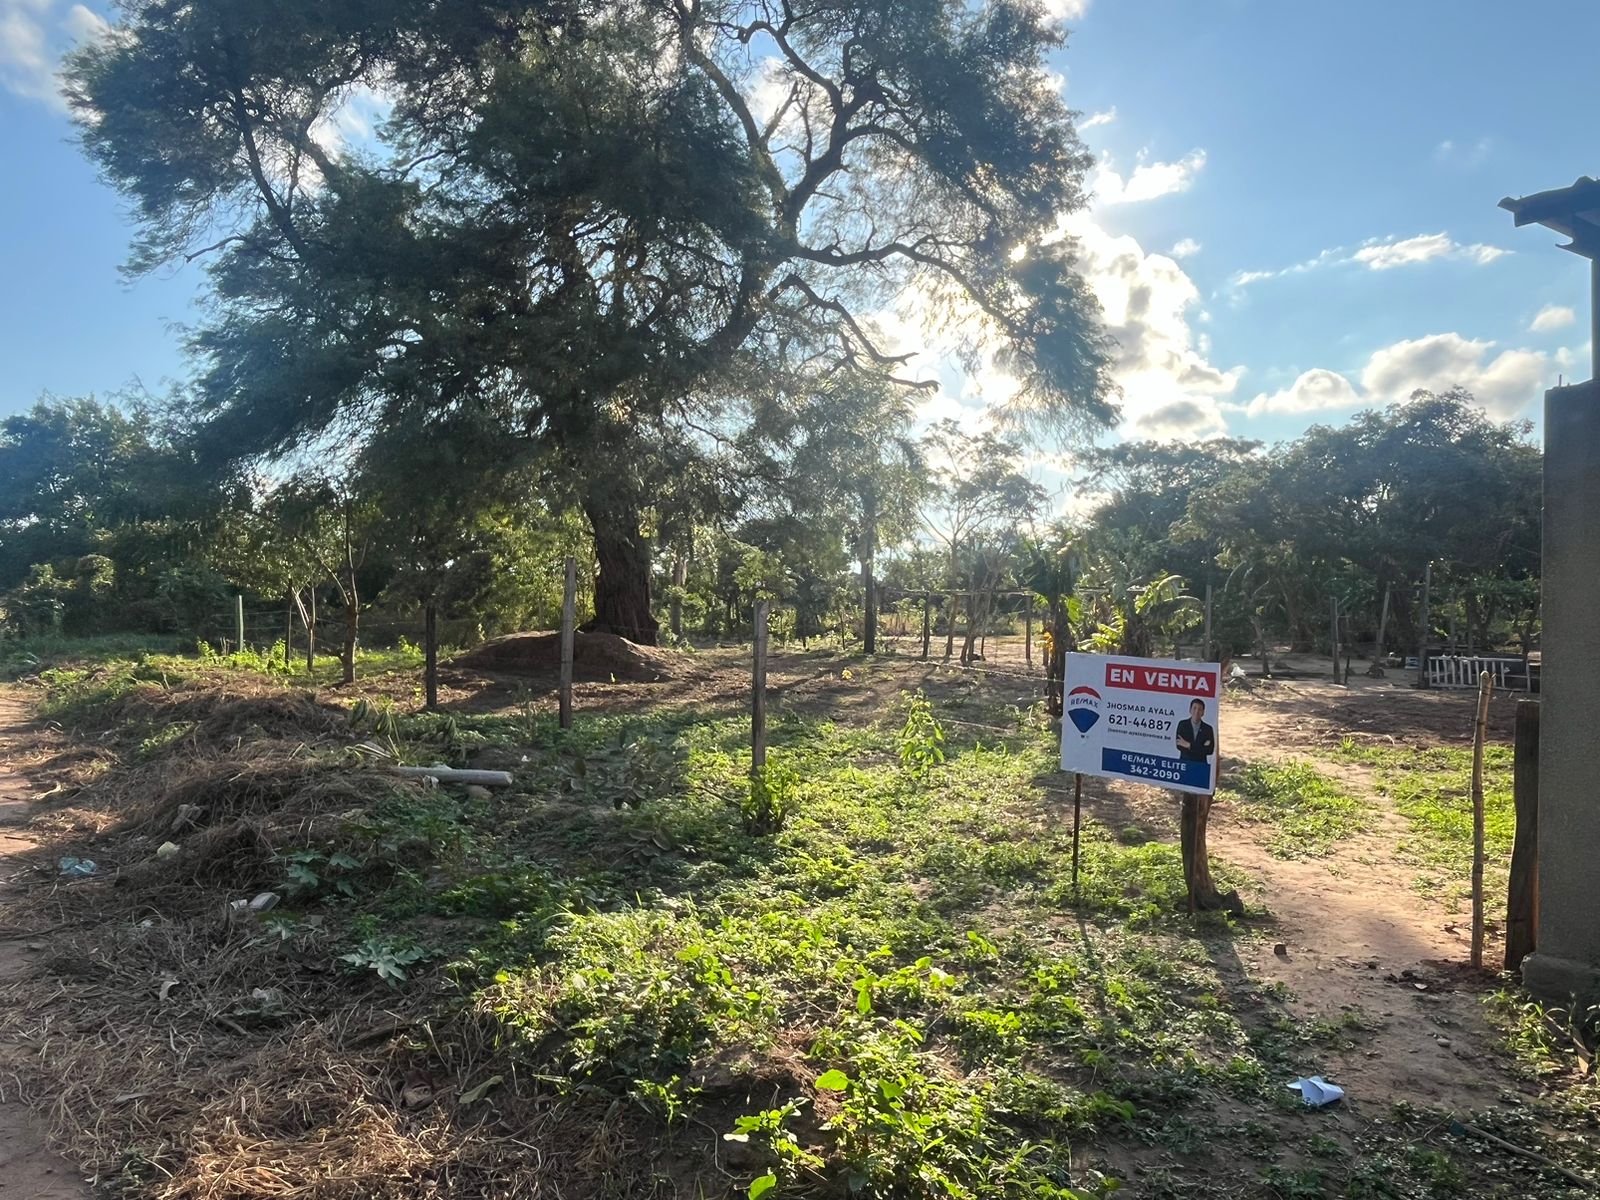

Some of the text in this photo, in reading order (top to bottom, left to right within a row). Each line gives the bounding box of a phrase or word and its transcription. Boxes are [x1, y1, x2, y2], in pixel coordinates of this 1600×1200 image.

[1110, 668, 1209, 691] EN VENTA
[1070, 698, 1098, 708] RE/MAX
[1106, 702, 1175, 716] JHOSMAR AYALA
[1108, 714, 1172, 731] 621-44887
[1121, 753, 1187, 771] RE/MAX ELITE
[1130, 765, 1181, 781] 342-2090
